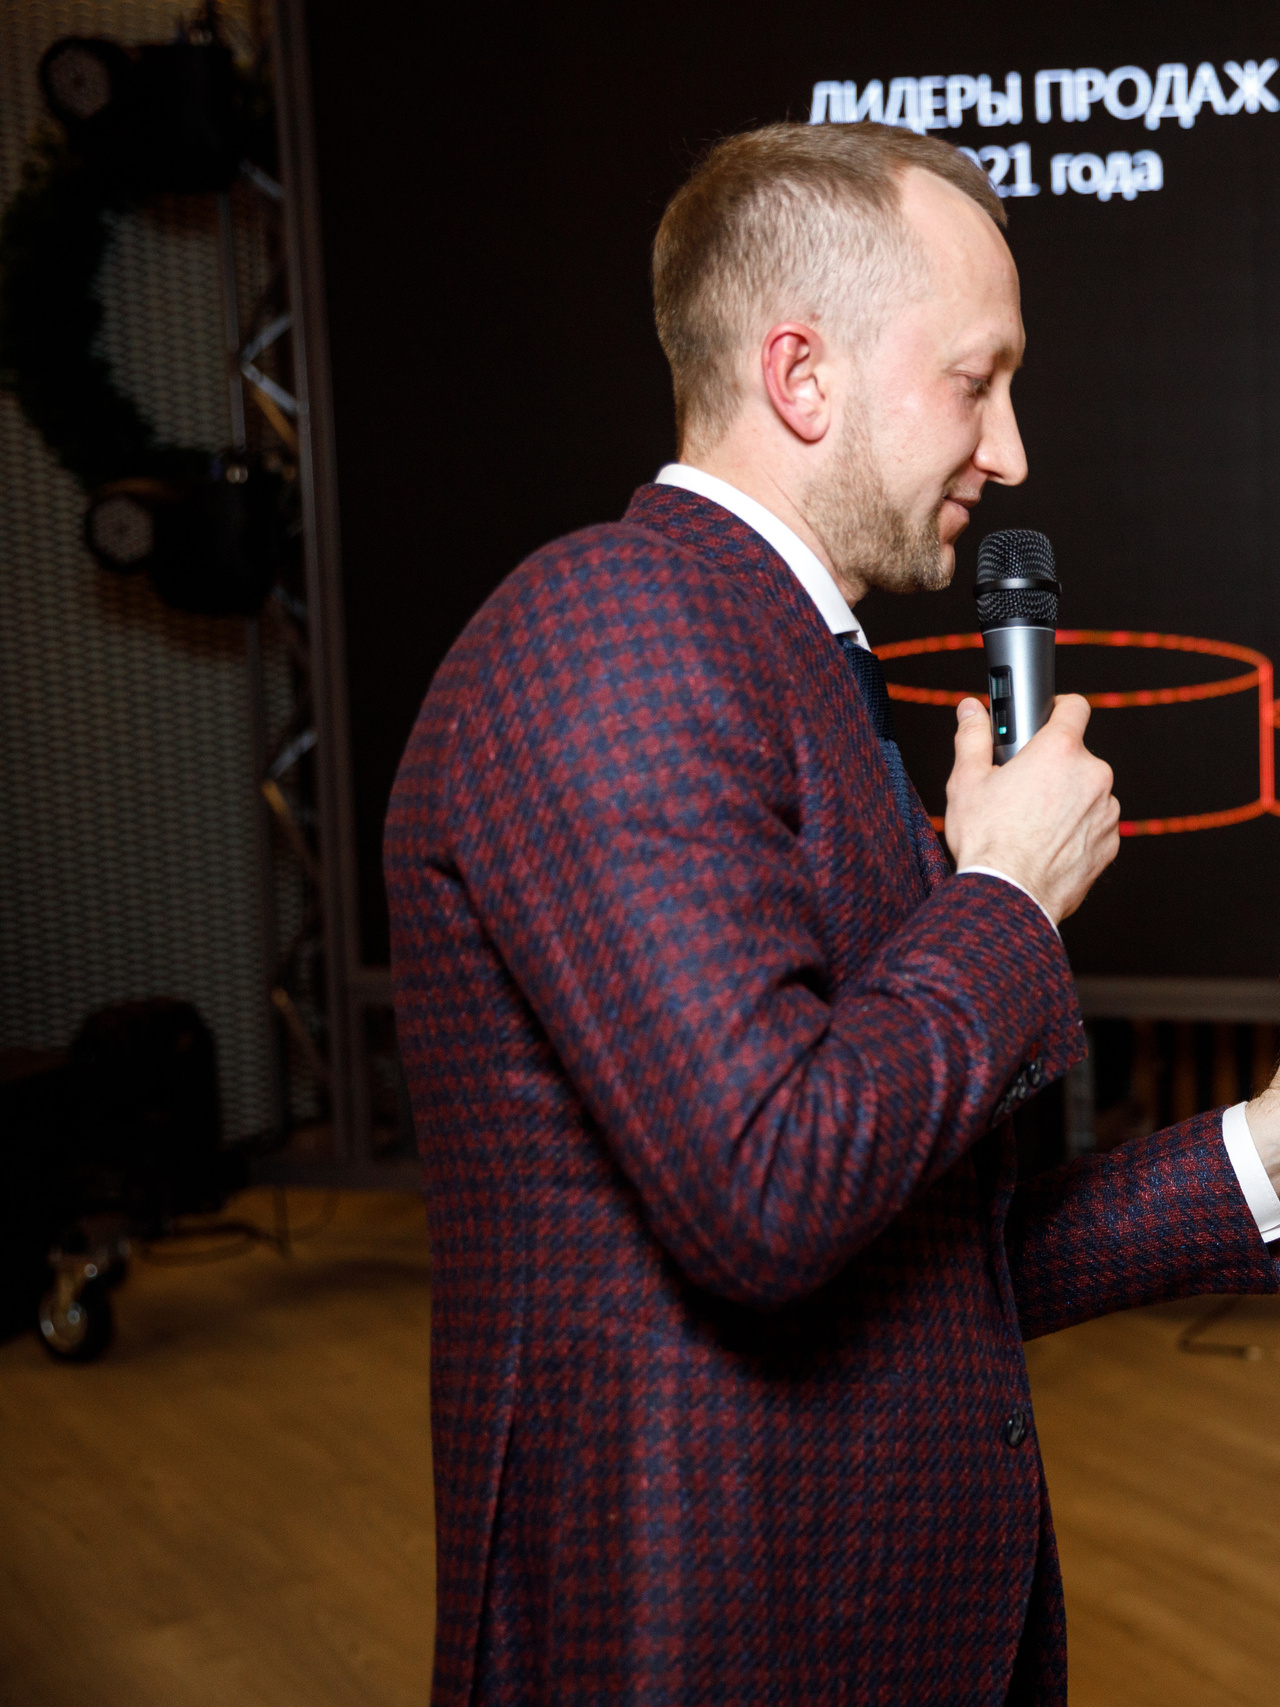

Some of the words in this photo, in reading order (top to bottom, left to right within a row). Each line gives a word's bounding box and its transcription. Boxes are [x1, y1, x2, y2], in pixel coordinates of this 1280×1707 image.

[809, 71, 1023, 135] ЛИДЕРЫ
[956, 141, 1040, 198] 21
[1050, 149, 1164, 201] года
